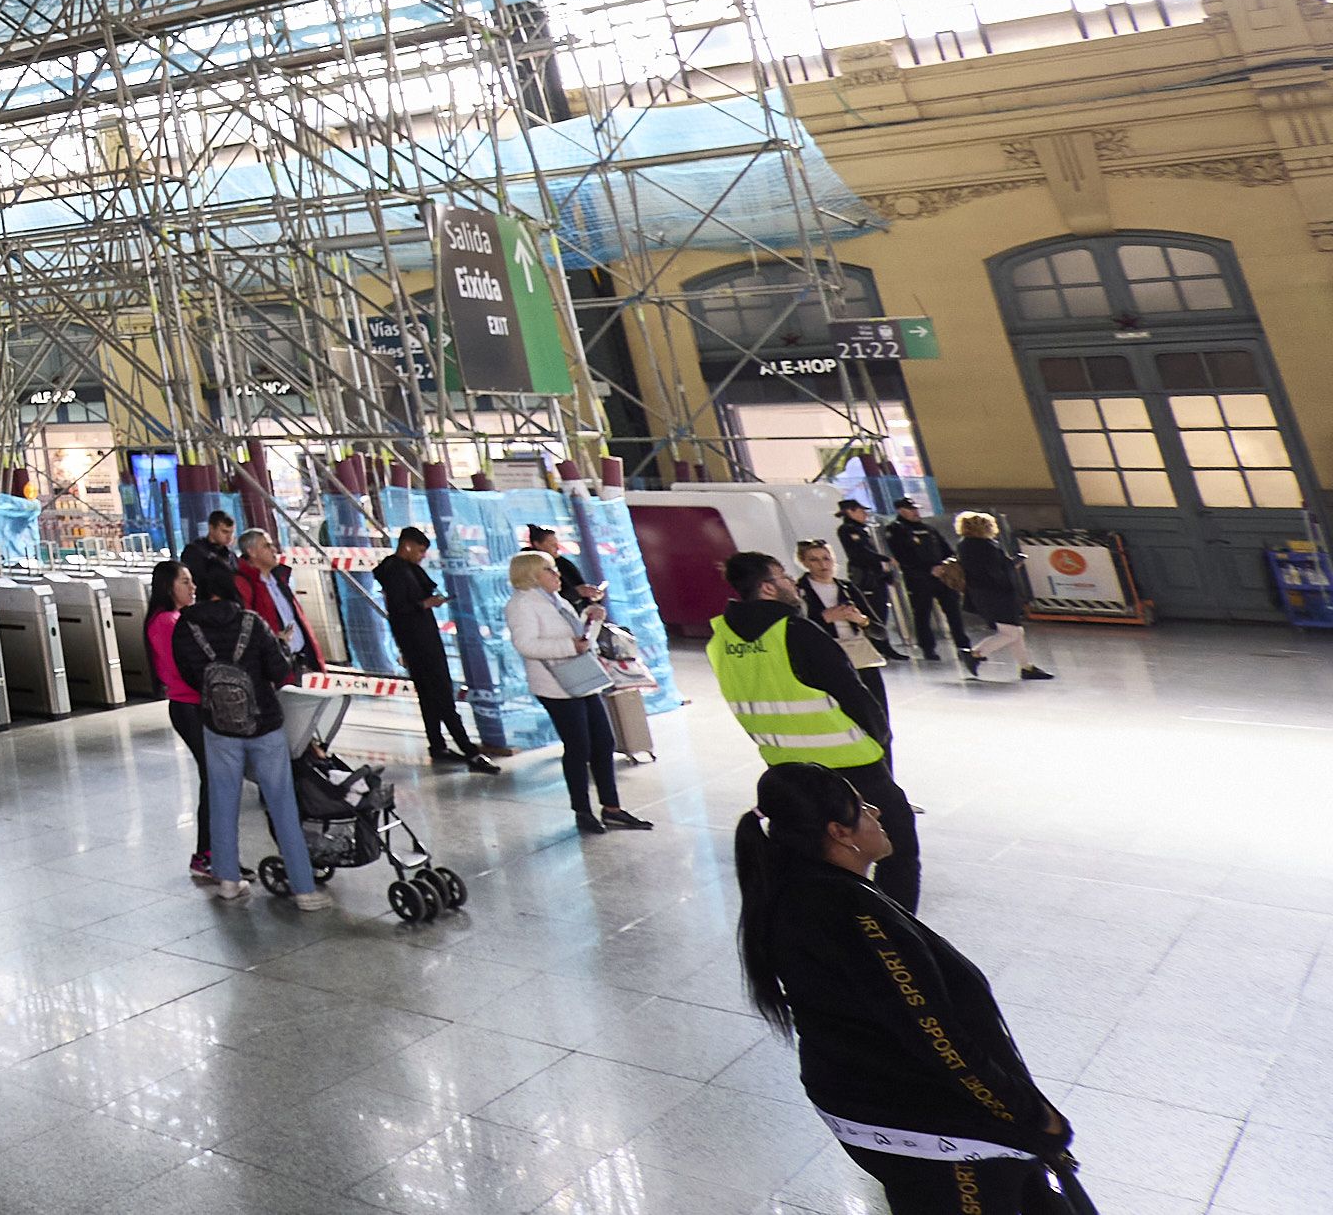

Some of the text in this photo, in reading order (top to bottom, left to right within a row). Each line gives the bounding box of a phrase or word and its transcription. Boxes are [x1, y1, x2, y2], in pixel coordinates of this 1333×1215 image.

[444, 219, 493, 255] Salida
[454, 266, 503, 302] Eixida
[369, 321, 400, 337] Vías
[486, 315, 510, 336] EXIT
[760, 358, 837, 376] ALE-HOP
[878, 949, 926, 1008] SPORT
[918, 1015, 967, 1071] SPORT
[954, 1162, 983, 1215] SPORT
